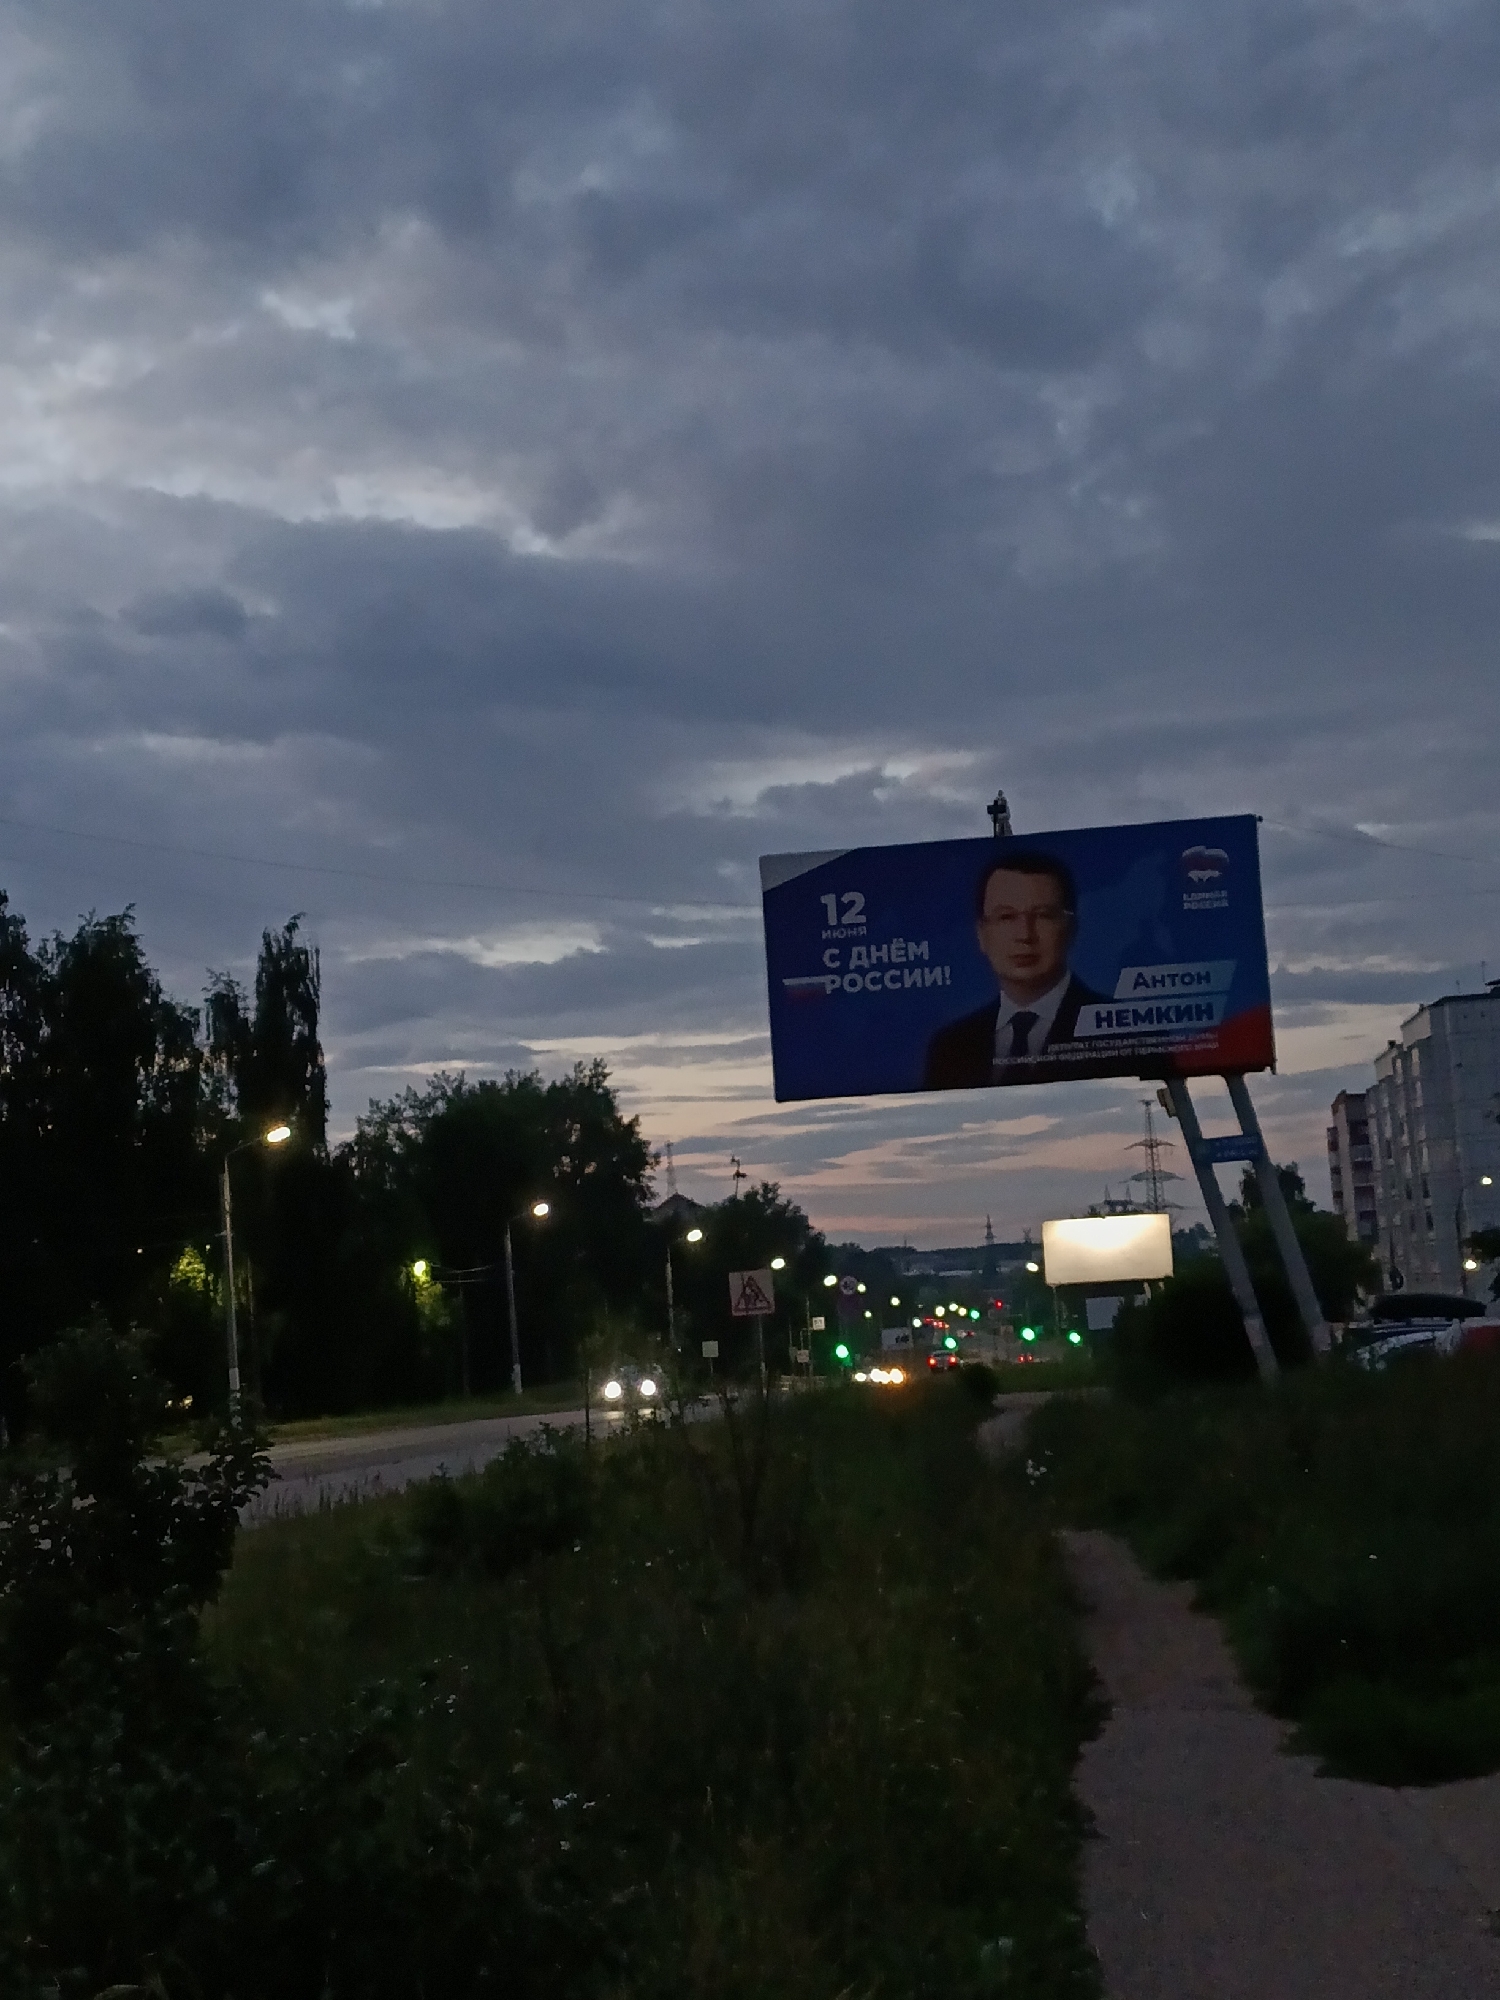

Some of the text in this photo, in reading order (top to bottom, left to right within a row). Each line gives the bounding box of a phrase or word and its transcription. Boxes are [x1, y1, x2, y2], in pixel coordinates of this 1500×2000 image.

[820, 891, 867, 926] 12
[821, 926, 867, 940] ИЮНЯ
[822, 937, 930, 970] С ДНЁМ
[824, 965, 953, 995] РОССИИ!
[1095, 1002, 1215, 1029] НЕМКИН
